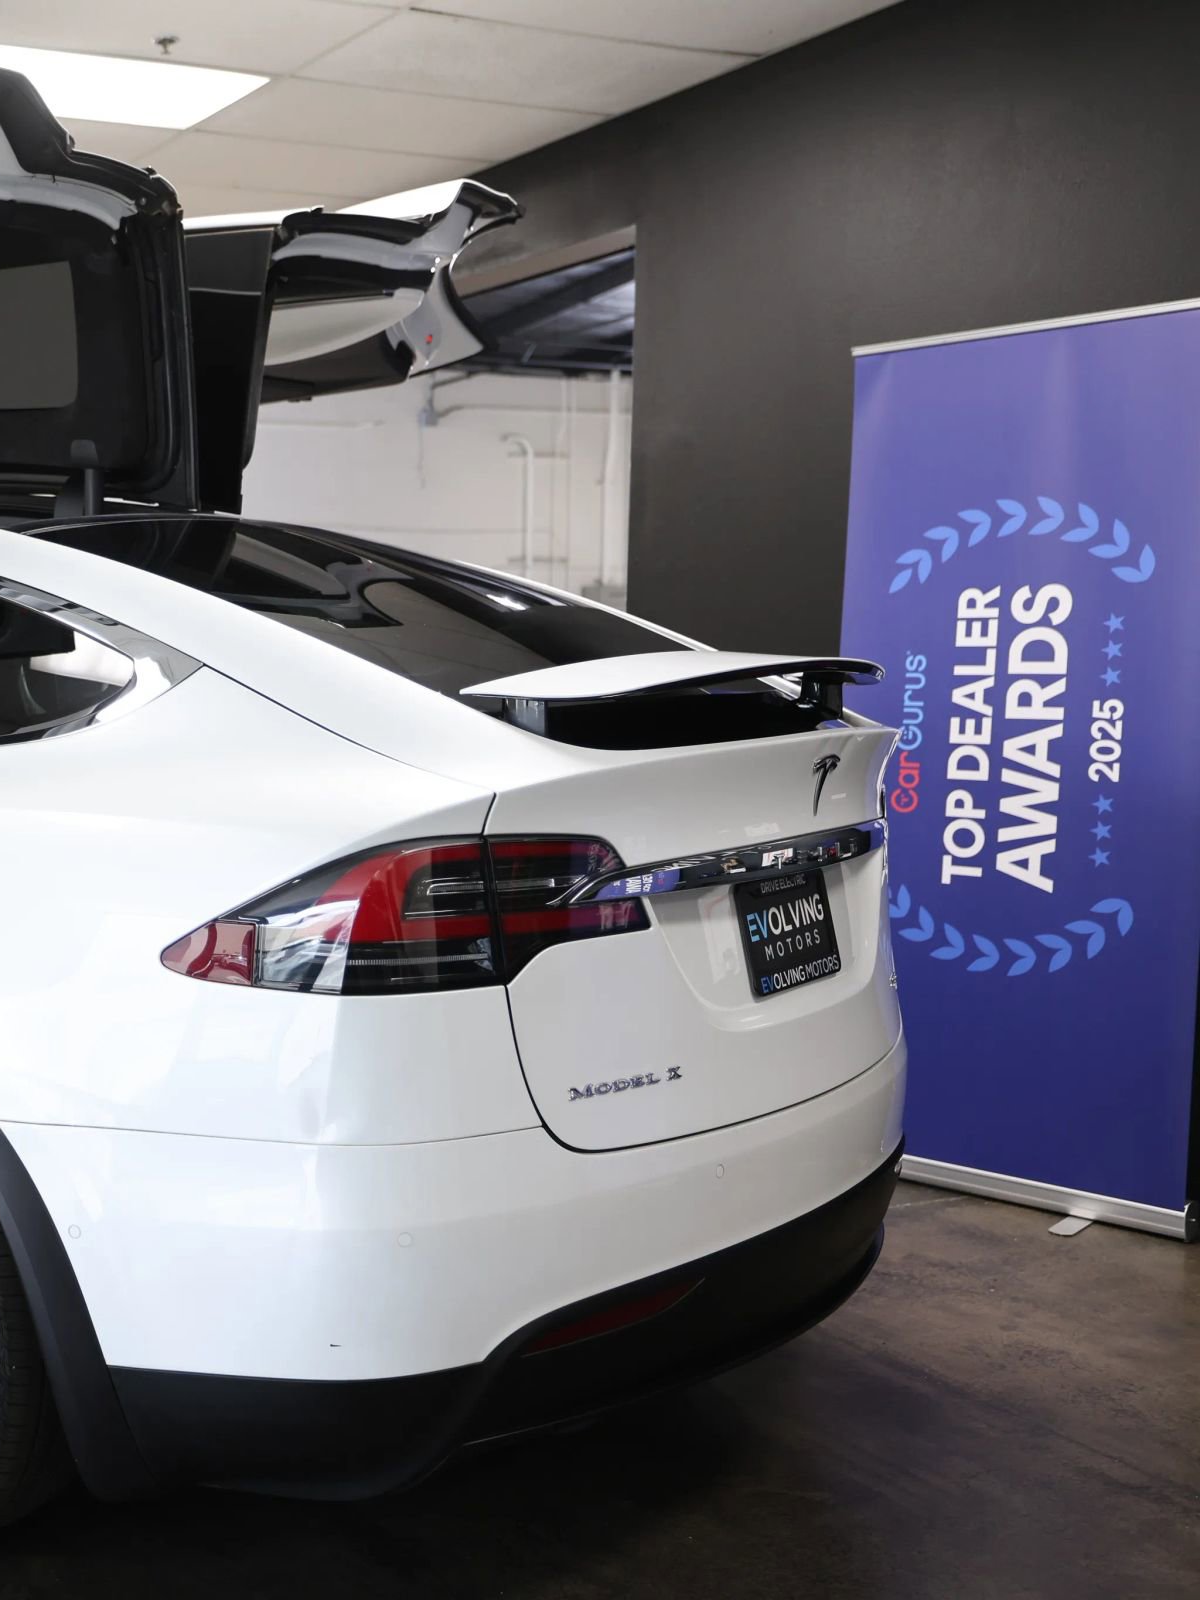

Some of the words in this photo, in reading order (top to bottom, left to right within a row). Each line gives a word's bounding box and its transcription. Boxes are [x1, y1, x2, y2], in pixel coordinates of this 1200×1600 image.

[947, 585, 1001, 782] DEALER
[891, 654, 928, 813] CarGurus
[996, 583, 1073, 894] AWARDS
[1088, 698, 1125, 783] 2025
[942, 789, 986, 885] TOP
[746, 893, 825, 943] EVOLVING
[760, 879, 780, 894] DRIVE
[760, 965, 806, 994] EVOLVING
[805, 954, 840, 979] MOTORS
[764, 929, 821, 961] MOTORS
[568, 1071, 661, 1102] MODEL
[665, 1065, 683, 1082] X
